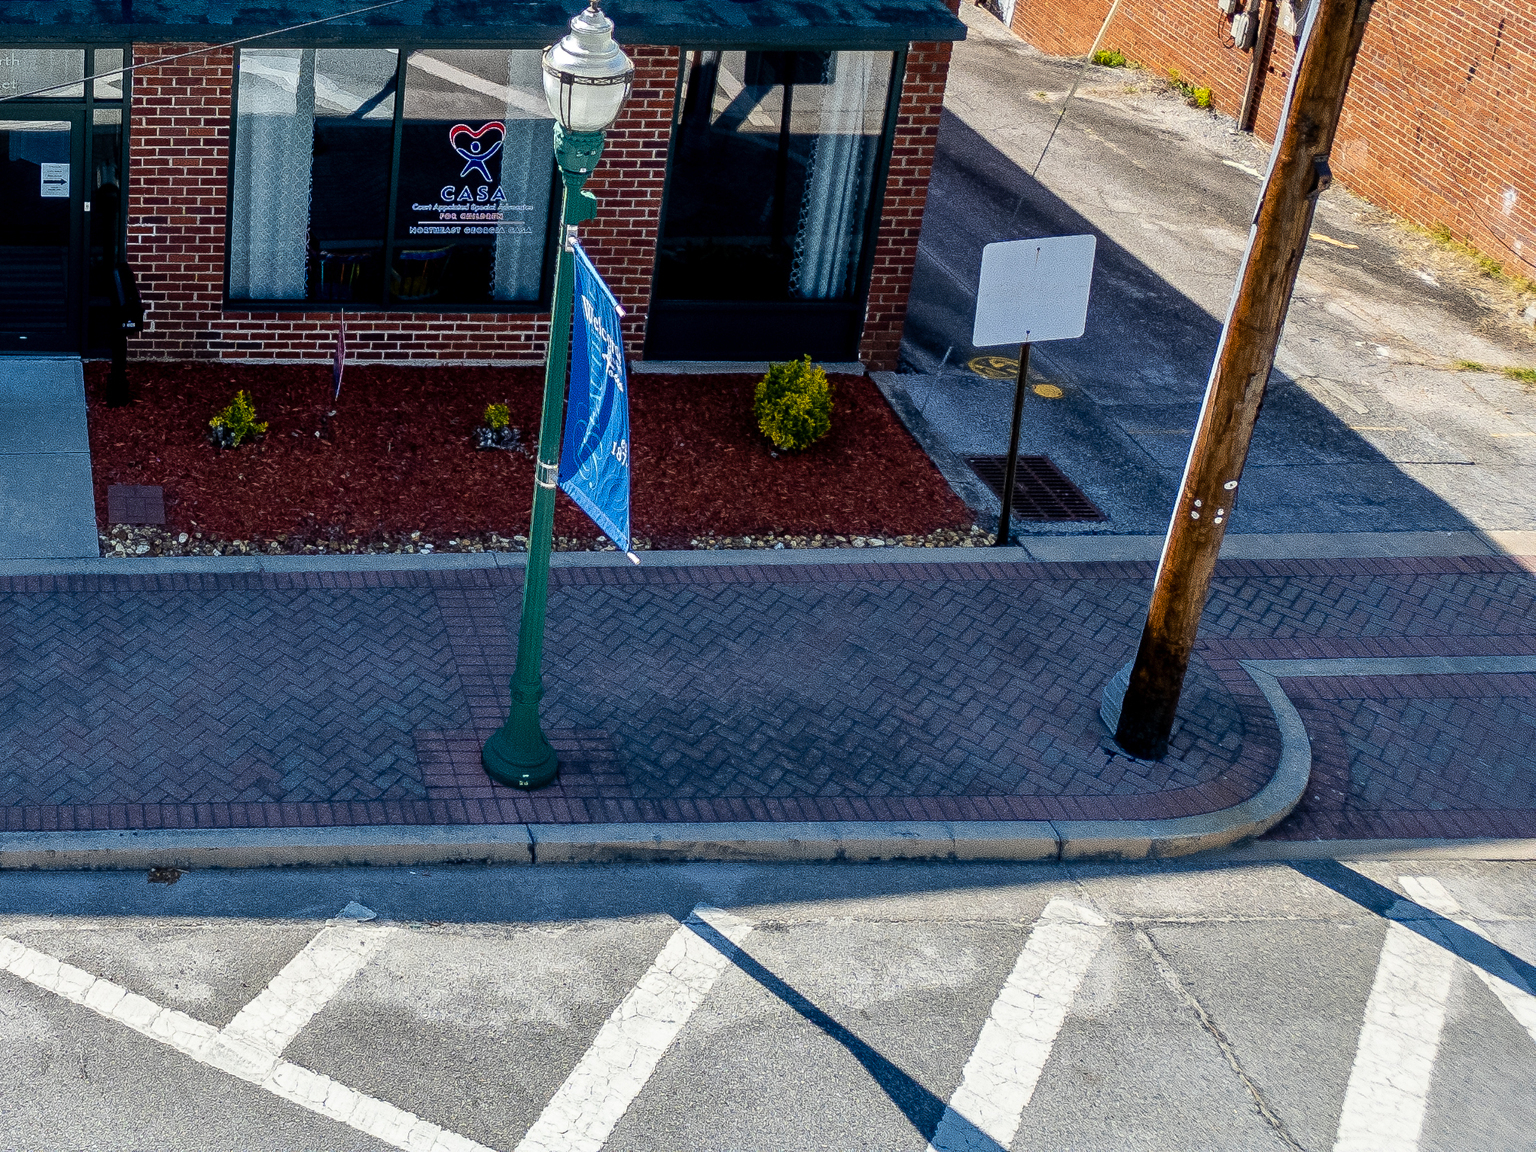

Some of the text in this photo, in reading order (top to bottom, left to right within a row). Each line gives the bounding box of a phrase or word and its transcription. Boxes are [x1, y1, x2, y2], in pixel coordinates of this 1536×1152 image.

[440, 185, 508, 202] CASA
[412, 203, 432, 211] Court
[433, 203, 469, 212] Appointed
[470, 203, 496, 212] Special
[439, 212, 504, 220] FOR CHILDREN
[409, 226, 533, 235] NORTHEAST GEORGIA CASA
